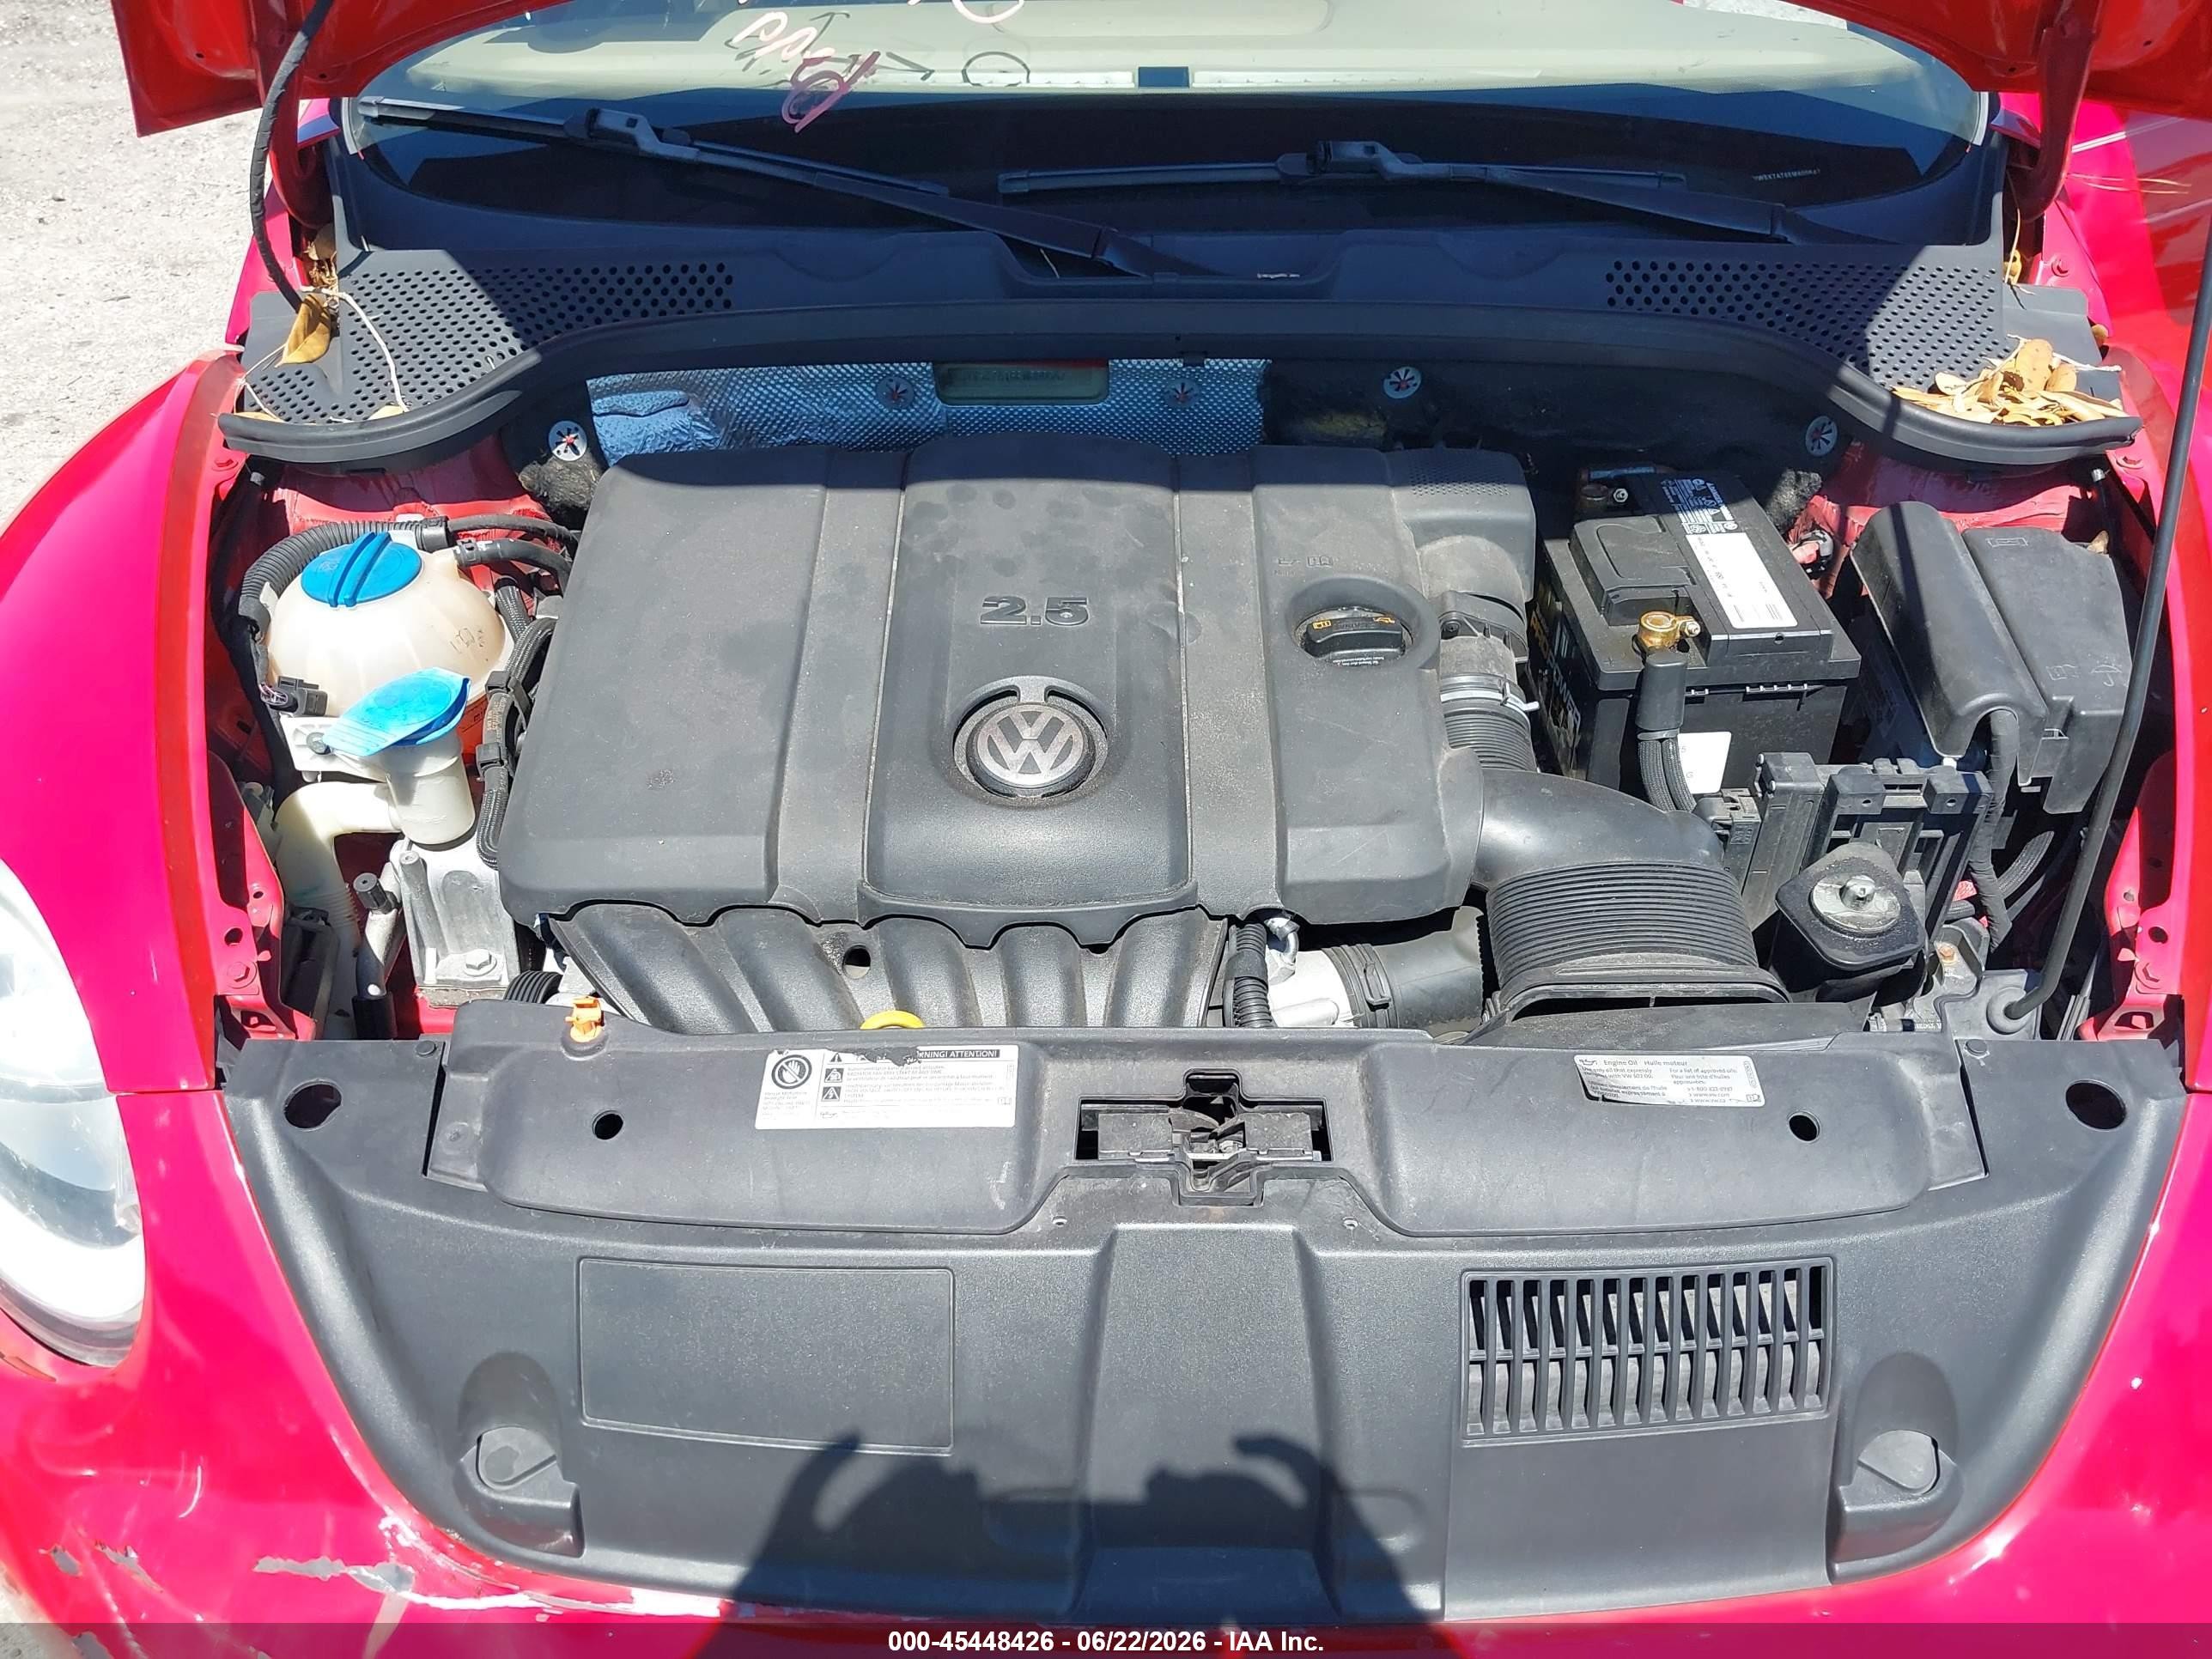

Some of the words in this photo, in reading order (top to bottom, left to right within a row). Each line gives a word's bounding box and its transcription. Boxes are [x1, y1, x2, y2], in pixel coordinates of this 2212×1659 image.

[980, 596, 1089, 626] 2.5
[917, 1050, 948, 1059] RNING!
[949, 1049, 998, 1058] ATTENTION!
